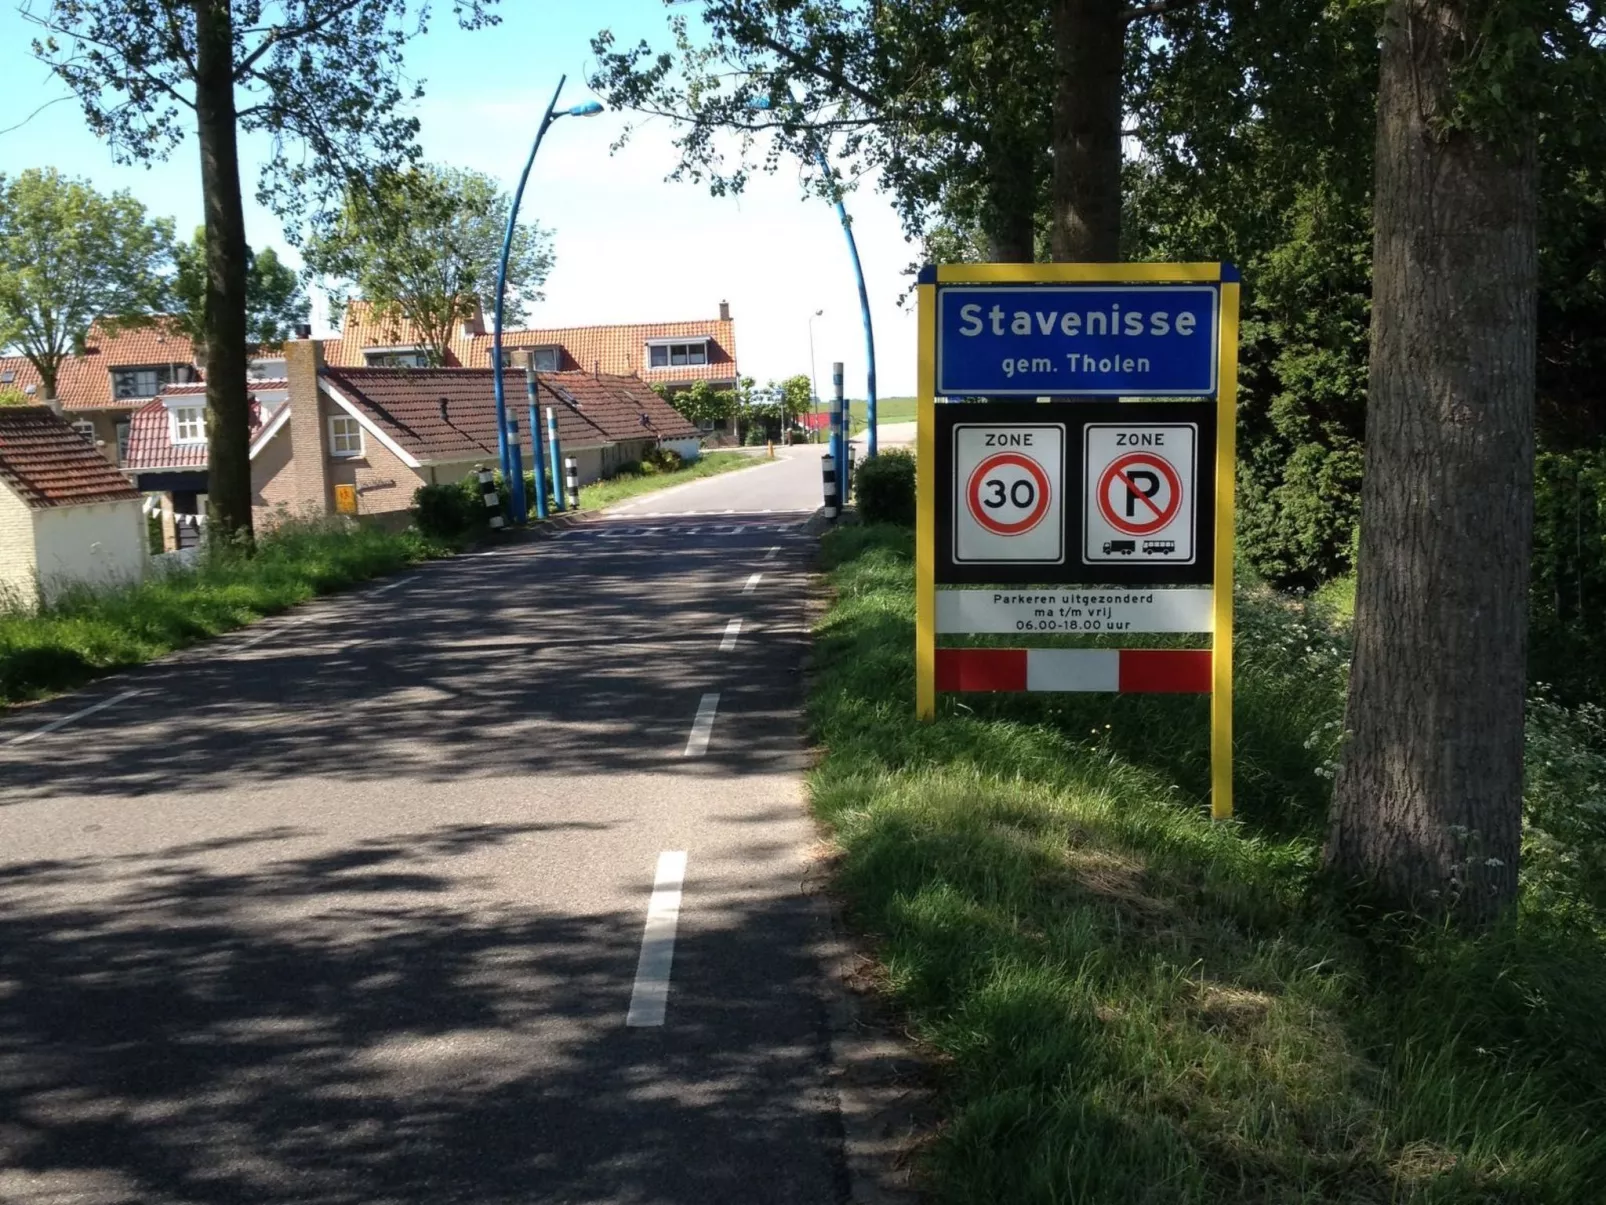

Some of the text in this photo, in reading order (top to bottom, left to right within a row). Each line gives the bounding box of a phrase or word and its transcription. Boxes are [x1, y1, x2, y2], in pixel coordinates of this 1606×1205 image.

[958, 303, 1197, 337] Stavenisse
[1002, 353, 1150, 378] gem. Tholen
[985, 433, 1034, 447] ZONE
[1116, 433, 1165, 447] ZONE
[983, 479, 1035, 509] 30
[1126, 470, 1160, 517] P
[993, 594, 1154, 606] Parkeren uitgezonderd
[1034, 606, 1112, 620] ma t/m vrij
[1016, 620, 1131, 631] 06.00-18.00 uur
